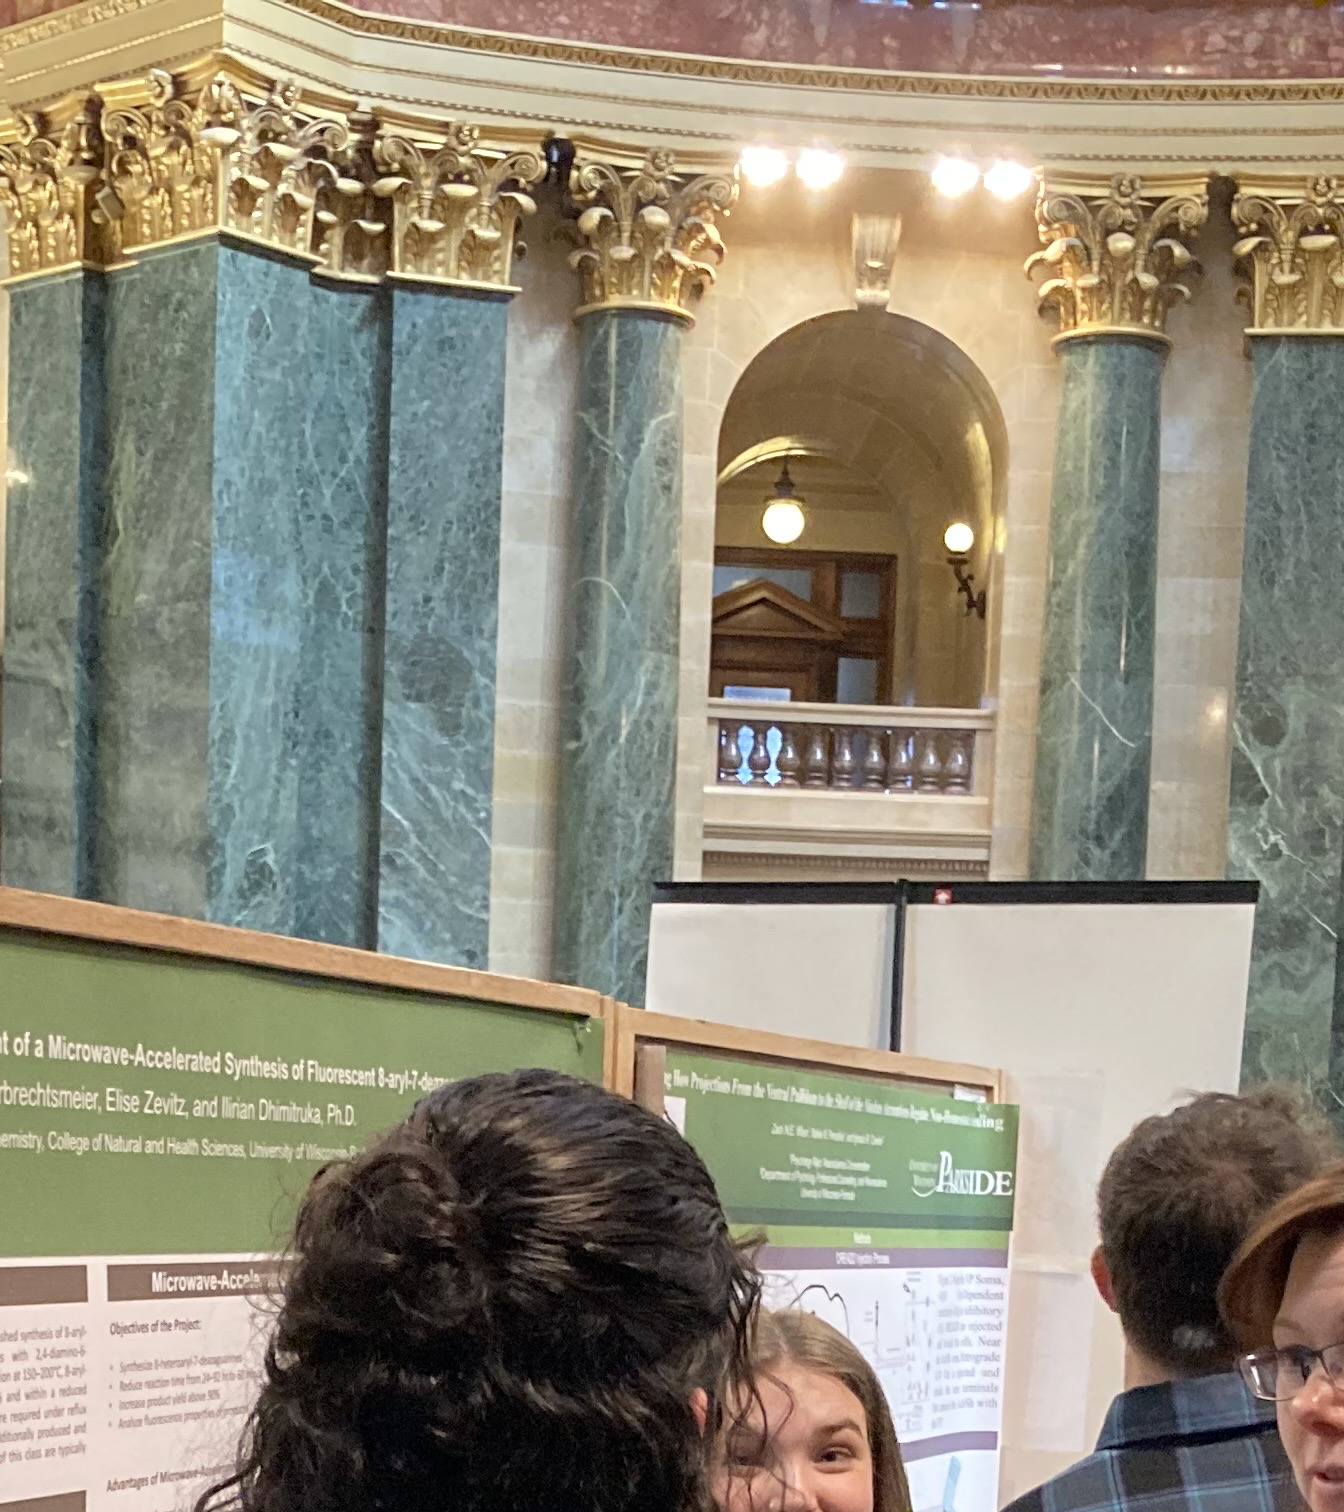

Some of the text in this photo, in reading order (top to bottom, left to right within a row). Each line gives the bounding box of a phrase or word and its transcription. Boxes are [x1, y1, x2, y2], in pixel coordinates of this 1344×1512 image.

[13, 1032, 30, 1056] of
[35, 1039, 44, 1058] a
[48, 1034, 221, 1073] Microwave-Accelerated
[225, 1052, 288, 1081] Synthesis
[292, 1059, 304, 1081] of
[308, 1060, 375, 1086] Fluorescent
[106, 1087, 139, 1114] Elise
[144, 1090, 189, 1120] Zevitz,
[193, 1096, 217, 1118] and
[259, 1099, 323, 1127] Dhimitruka,
[327, 1104, 356, 1126] Ph.D.
[48, 1131, 89, 1156] College
[92, 1133, 103, 1151] of
[105, 1134, 142, 1153] Natural
[144, 1138, 164, 1154] and
[167, 1137, 199, 1155] Health
[201, 1139, 246, 1160] Sciences,
[249, 1140, 293, 1163] University
[152, 1269, 262, 1293] Microwave-Accele
[109, 1320, 149, 1336] Objectives
[151, 1320, 159, 1333] of
[978, 1337, 1002, 1348] Near
[982, 1367, 1000, 1378] and
[107, 1476, 149, 1493] Advantages
